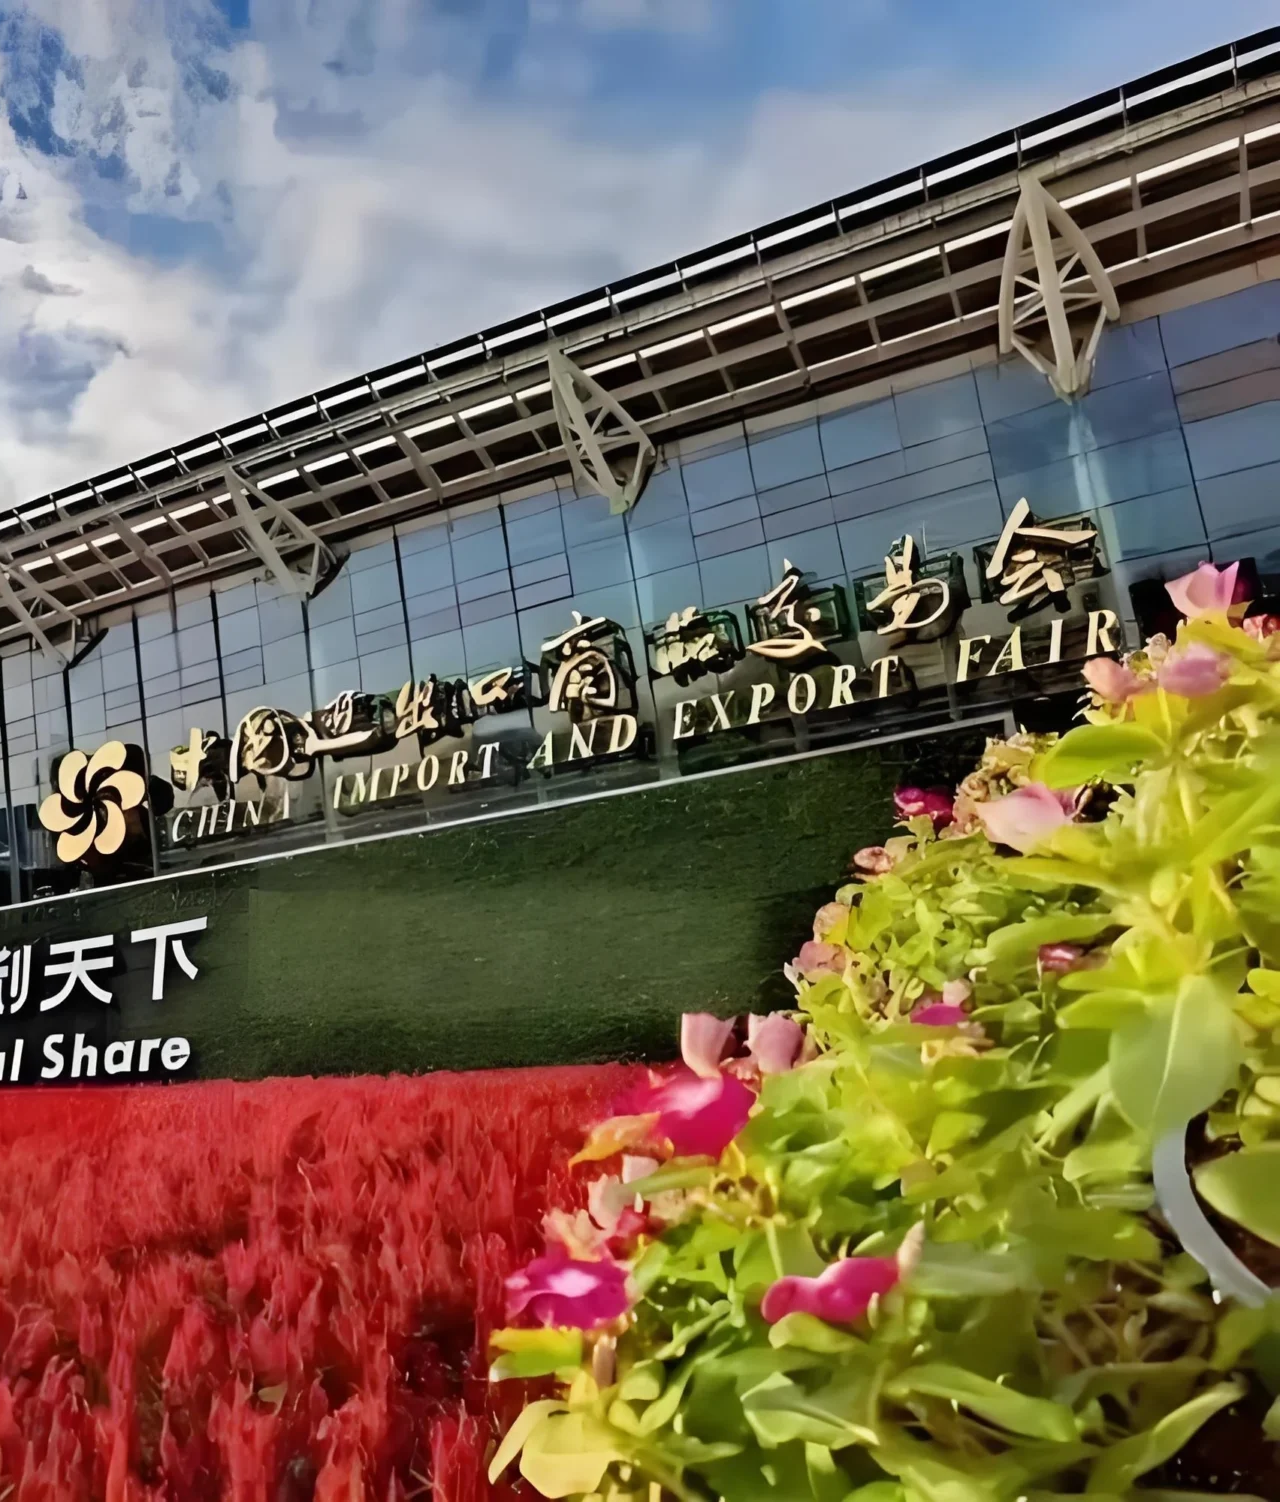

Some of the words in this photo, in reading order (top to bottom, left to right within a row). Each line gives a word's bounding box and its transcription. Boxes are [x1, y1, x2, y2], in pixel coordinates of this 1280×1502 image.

[332, 742, 500, 810] IMPORT
[526, 713, 638, 770] AND
[673, 655, 900, 740] EXPORT
[955, 609, 1117, 683] FAIR
[40, 1033, 191, 1080] Share
